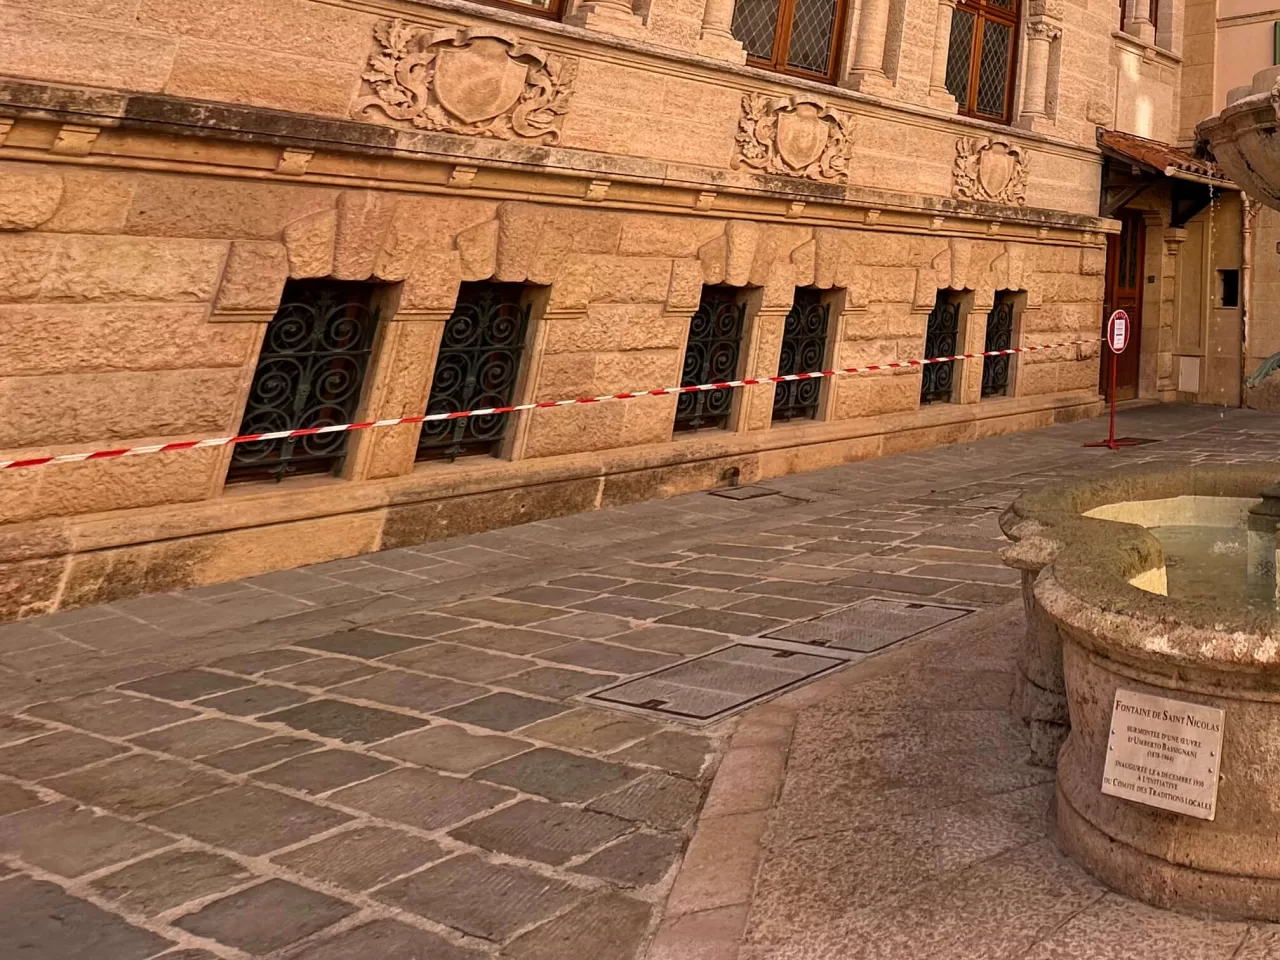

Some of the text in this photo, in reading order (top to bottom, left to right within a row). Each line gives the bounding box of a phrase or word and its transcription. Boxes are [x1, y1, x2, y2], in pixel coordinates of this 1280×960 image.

[1115, 699, 1220, 732] FONTAINE DE SAINT NICOLAS
[1162, 742, 1197, 759] BASSIGNANI
[1149, 768, 1156, 776] LE
[1104, 777, 1112, 785] DU
[1136, 785, 1147, 794] DES
[1148, 787, 1184, 804] TRADITIONS
[1184, 797, 1212, 811] LOCALES
